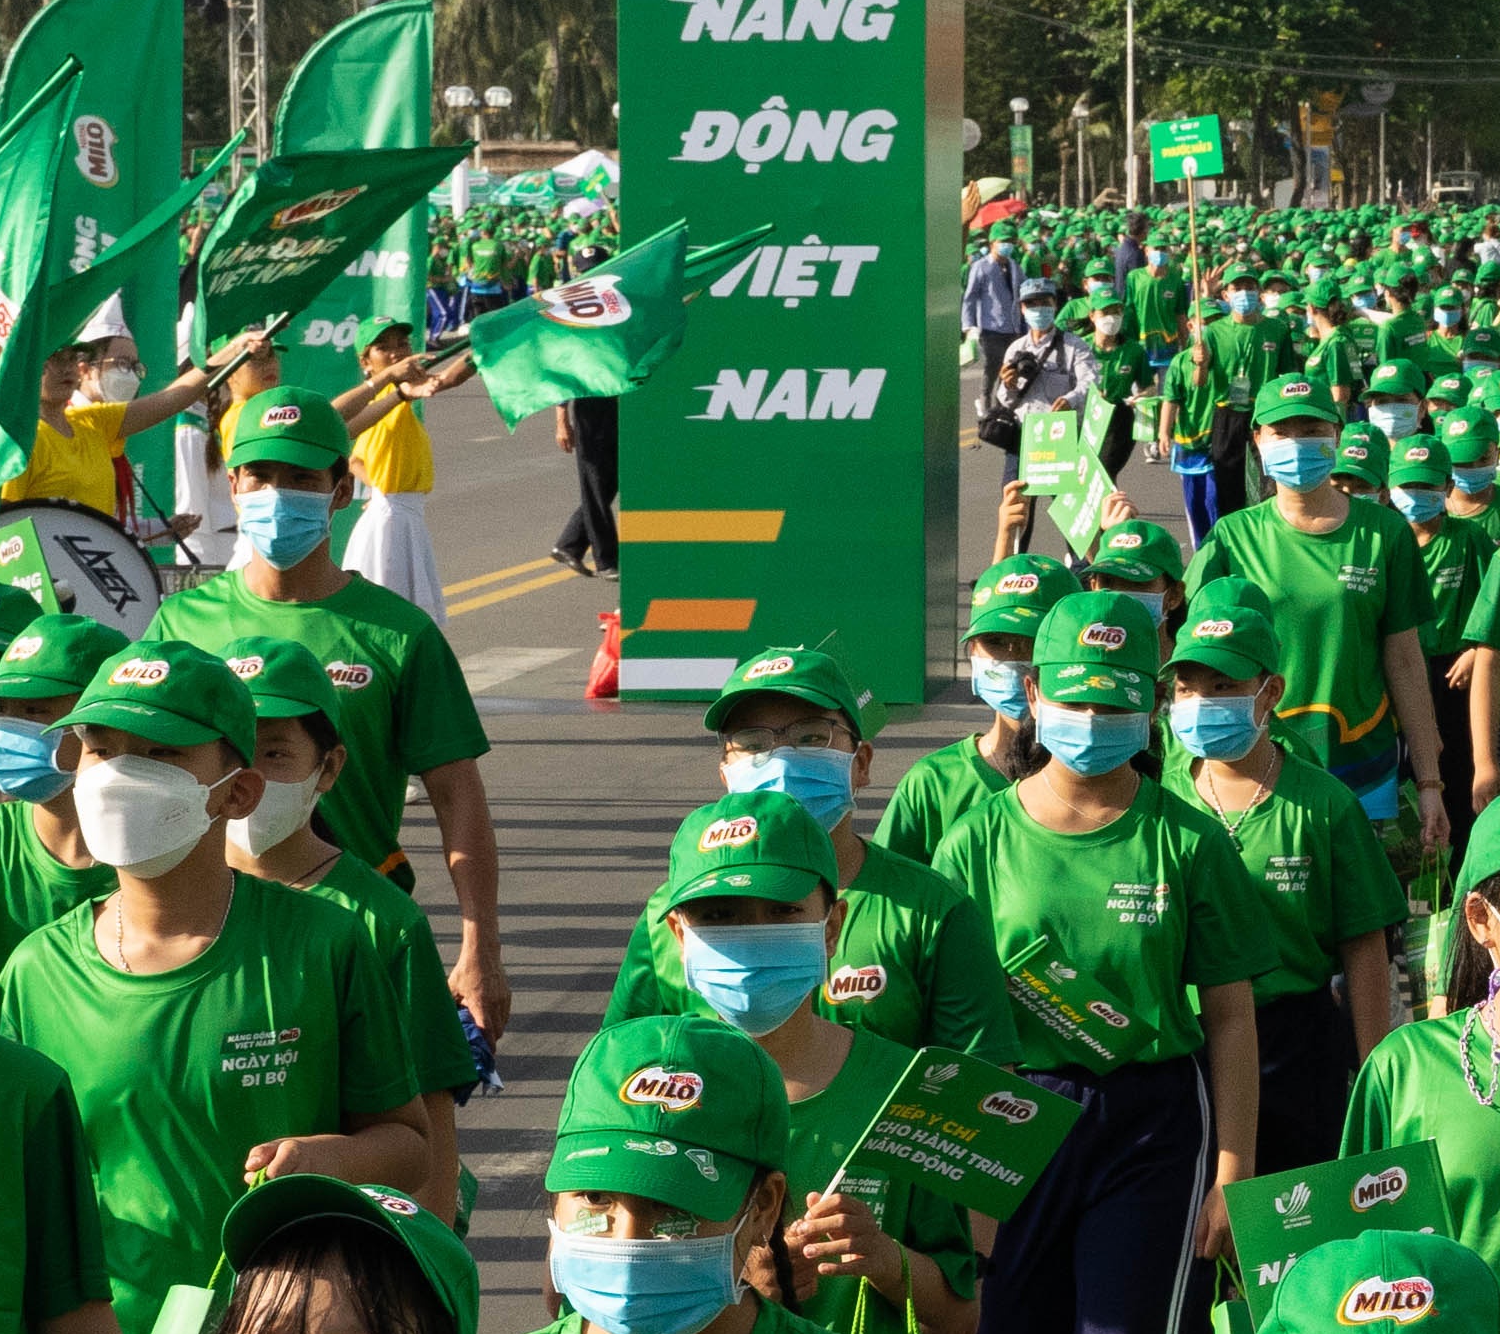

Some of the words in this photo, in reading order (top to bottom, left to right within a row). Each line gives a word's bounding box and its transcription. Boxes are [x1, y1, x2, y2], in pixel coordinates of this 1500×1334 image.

[668, 95, 899, 174] ĐỘNG
[88, 123, 107, 184] MILO
[686, 368, 887, 421] NAM
[119, 661, 165, 683] MILO
[706, 819, 752, 846] MILO
[833, 974, 881, 996] MILO
[221, 1052, 270, 1074] NGÀY
[241, 1070, 260, 1088] ĐI
[263, 1067, 289, 1090] BỘ
[628, 1077, 697, 1101] MILO
[988, 1096, 1033, 1119] MILO
[887, 1102, 927, 1121] TIẾP
[928, 1113, 940, 1128] Ý
[942, 1119, 979, 1143] CHÍ
[863, 1137, 918, 1166] NĂNG
[917, 1156, 965, 1186] ĐỘNG
[875, 1120, 907, 1139] CHO
[908, 1127, 968, 1161] HÀNH
[966, 1151, 1025, 1186] TRÌNH
[1357, 1180, 1406, 1203] MILO
[1354, 1290, 1430, 1314] MILO
